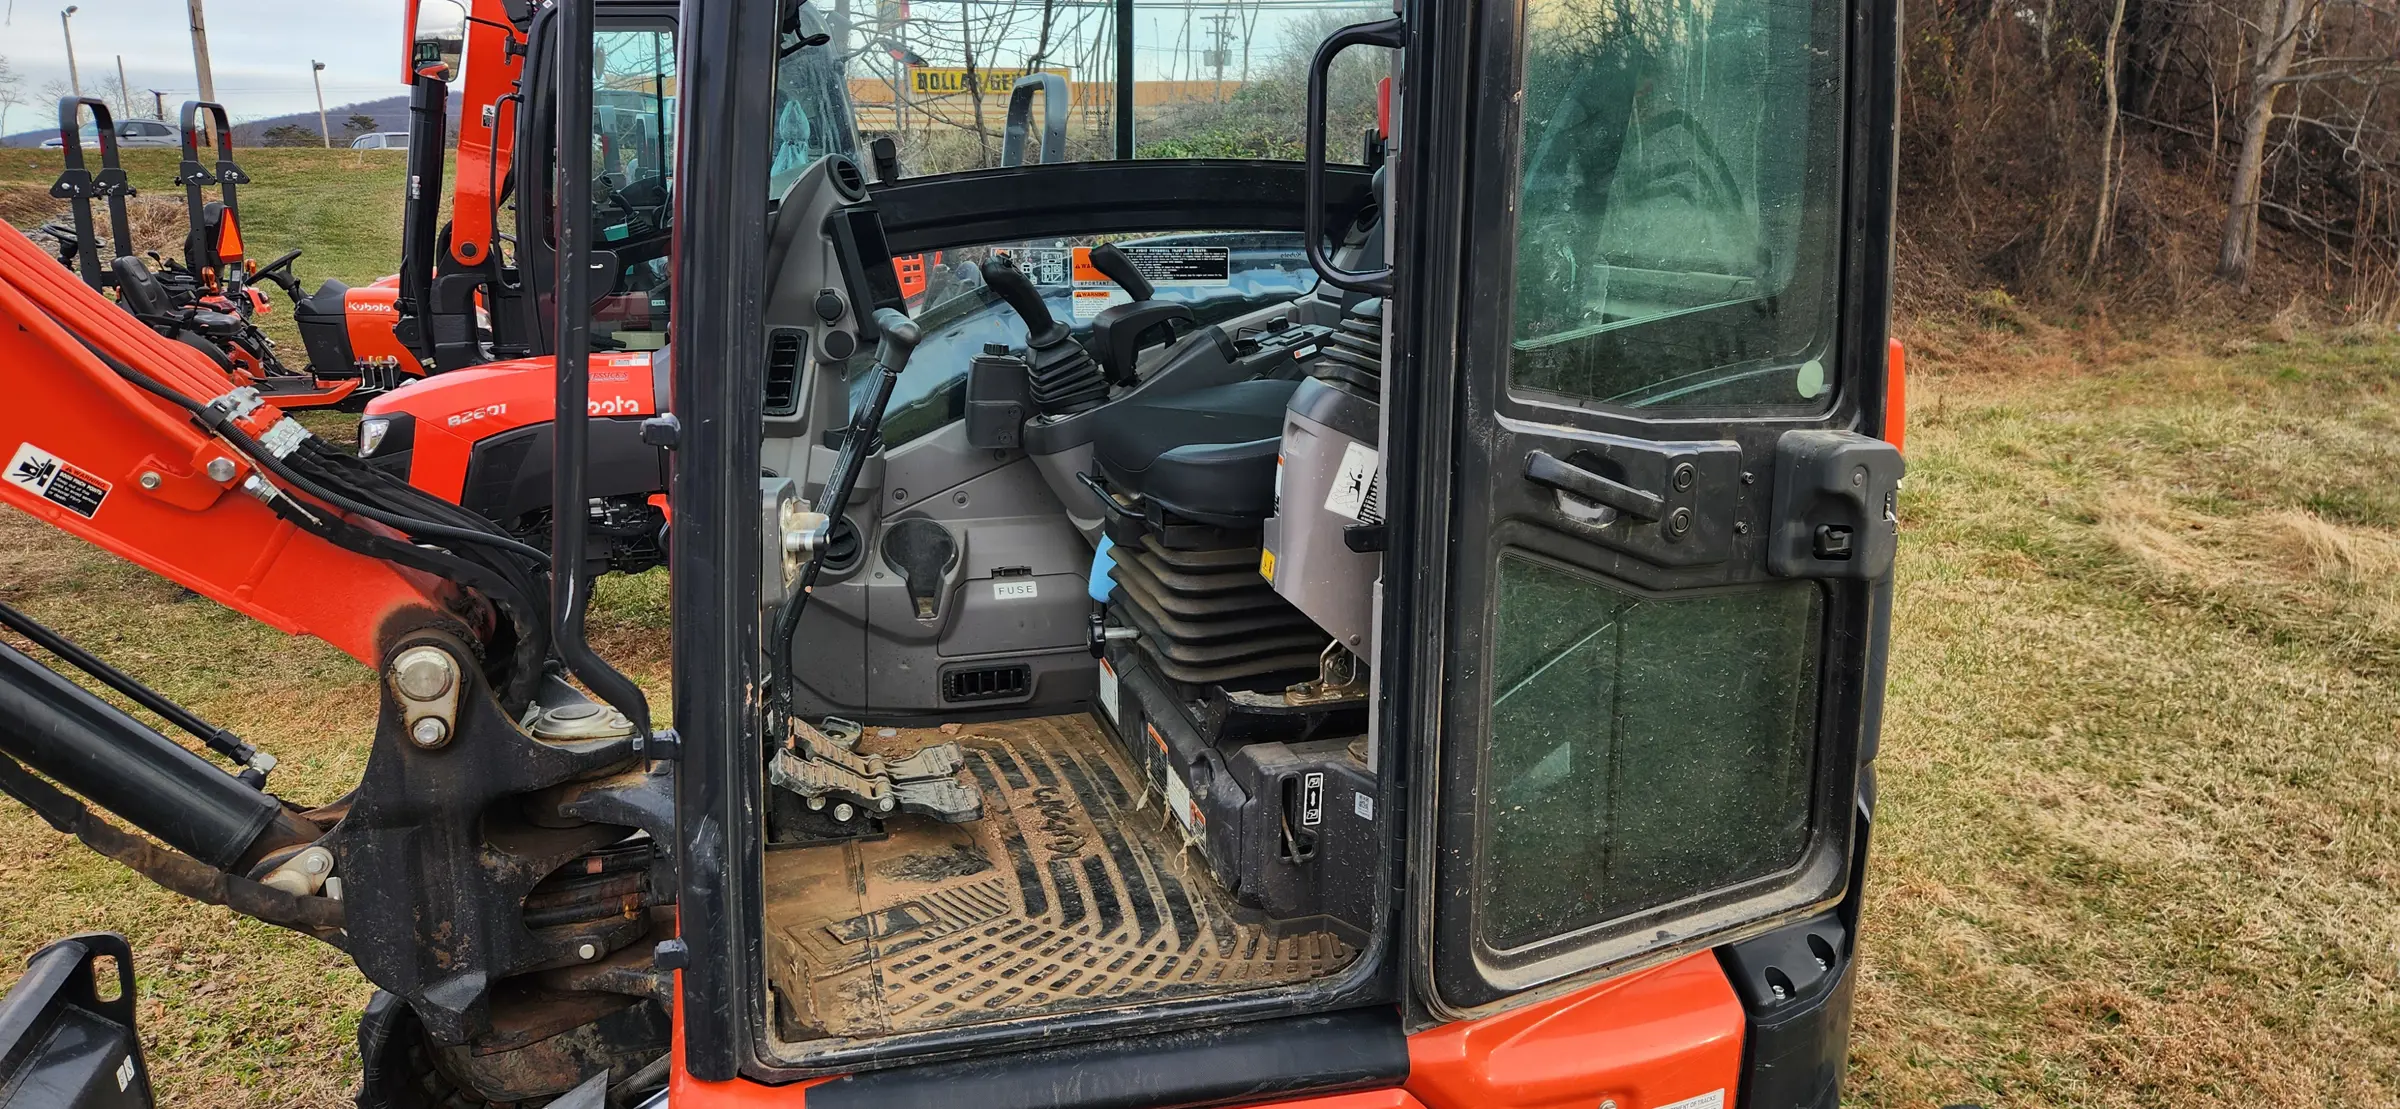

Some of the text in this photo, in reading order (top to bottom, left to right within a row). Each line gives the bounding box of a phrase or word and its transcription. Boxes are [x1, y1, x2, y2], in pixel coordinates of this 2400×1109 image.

[348, 301, 391, 312] Kubota
[588, 396, 639, 414] bota
[448, 403, 507, 427] B2601
[74, 469, 106, 489] WARNING
[998, 585, 1033, 595] FUSE
[1697, 1094, 1716, 1105] TRACKS
